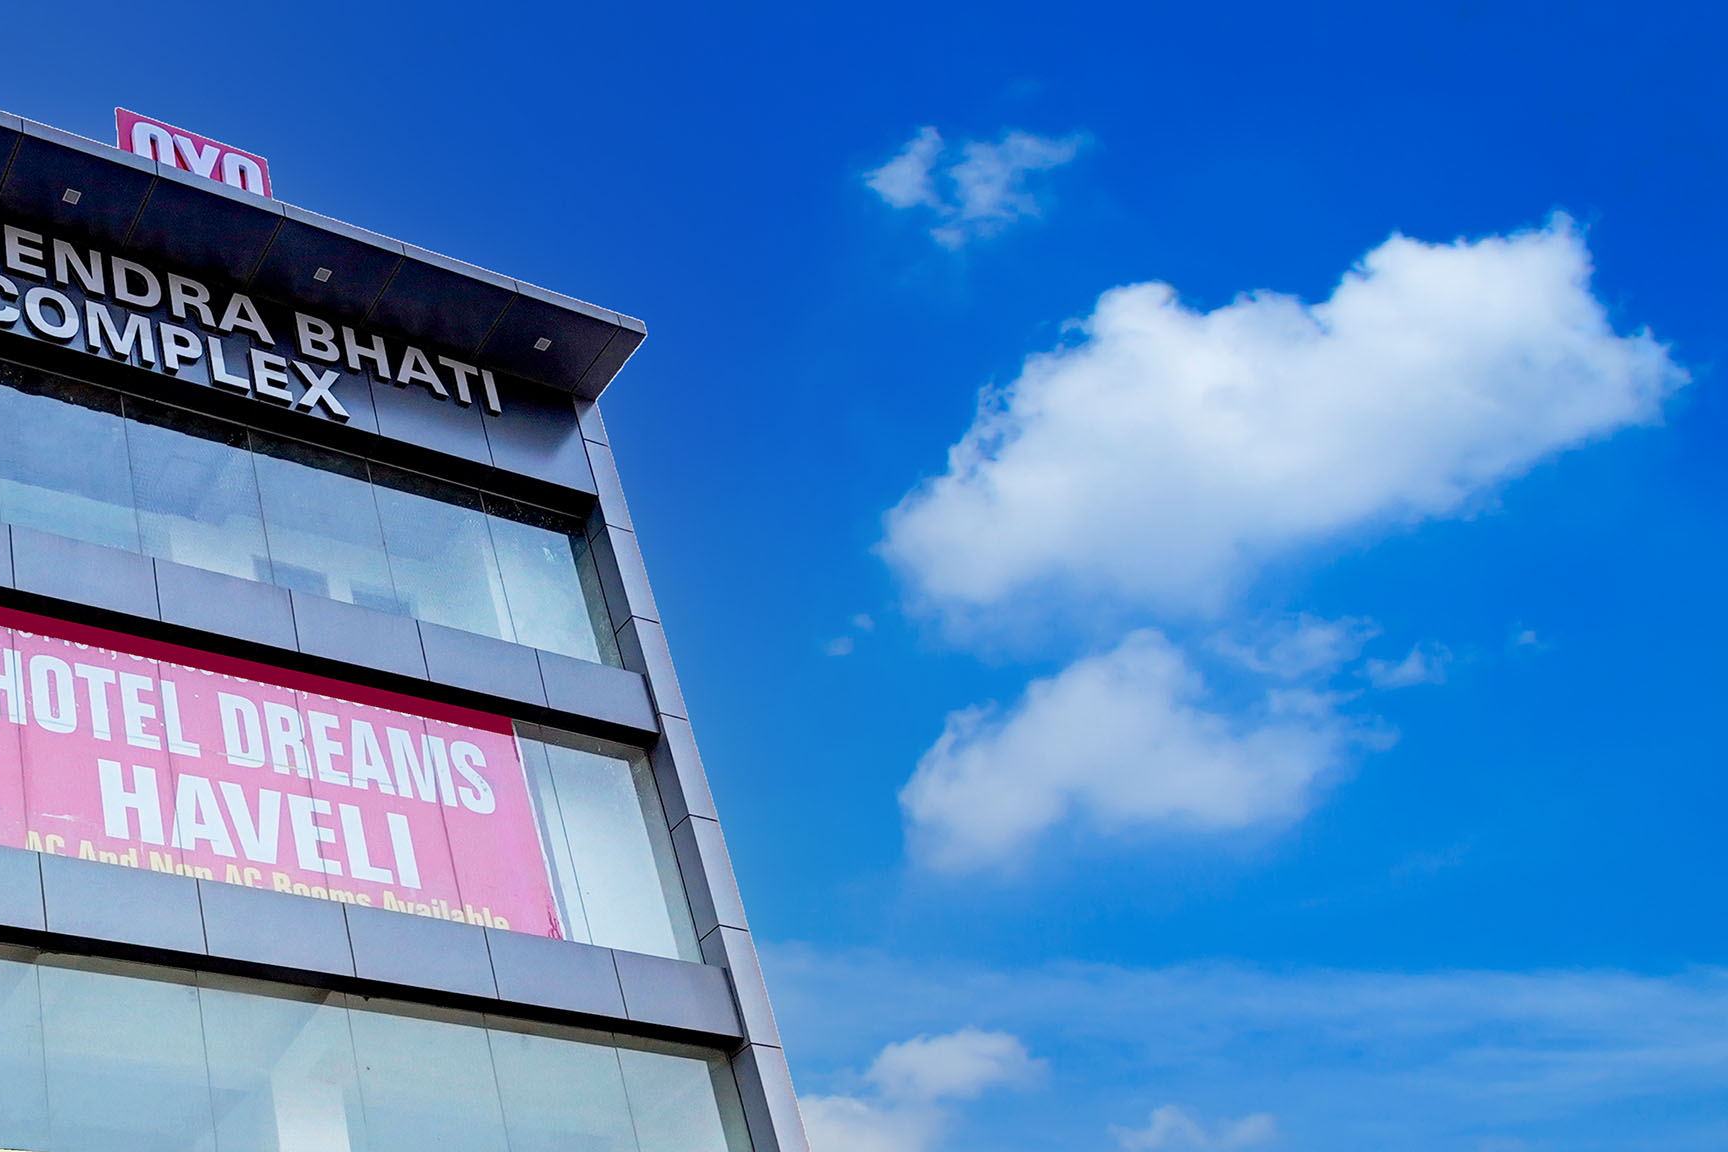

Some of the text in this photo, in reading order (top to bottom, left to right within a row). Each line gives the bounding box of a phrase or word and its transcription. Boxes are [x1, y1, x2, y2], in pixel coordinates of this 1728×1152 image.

[293, 311, 503, 416] BHATI
[218, 691, 497, 815] DREAMS
[98, 757, 421, 890] HAVELI
